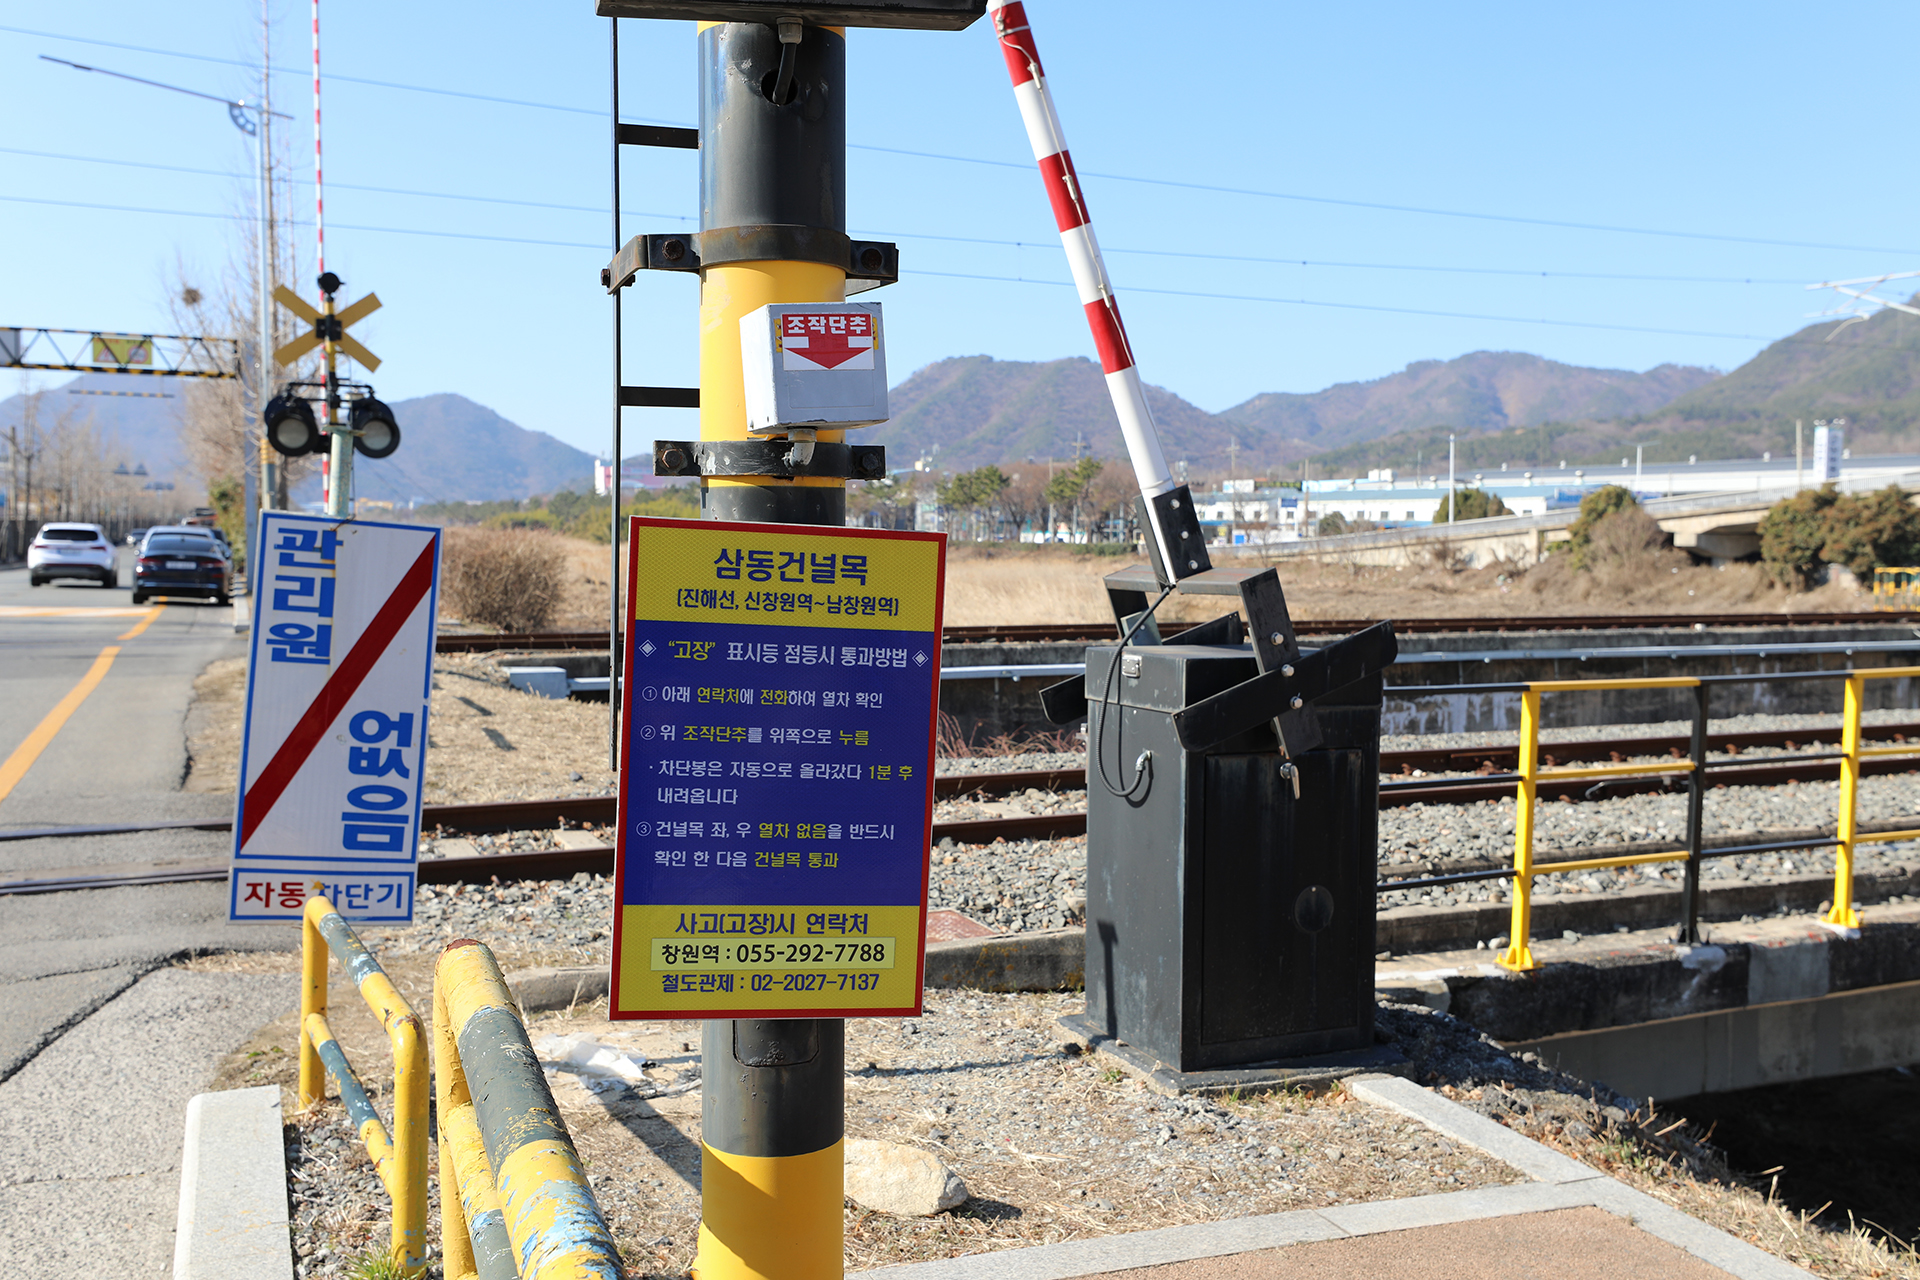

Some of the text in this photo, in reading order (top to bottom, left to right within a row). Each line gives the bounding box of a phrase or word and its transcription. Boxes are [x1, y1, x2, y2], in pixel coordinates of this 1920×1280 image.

[787, 316, 867, 334] 조작단추
[713, 548, 868, 585] 삼동건널목
[266, 527, 344, 665] 관리원
[727, 642, 778, 664] 표시등
[784, 644, 835, 665] 점등시
[841, 646, 907, 668] 통과방법
[662, 686, 691, 703] 아래
[697, 687, 754, 704] 연락처에
[760, 689, 816, 706] 전화하여
[822, 691, 850, 708] 열차
[855, 692, 883, 708] 확인
[660, 725, 676, 740] 위
[683, 726, 762, 743] 조작단추를
[769, 728, 831, 744] 위쪽으로
[839, 730, 869, 745] 누름
[341, 710, 415, 852] 없음
[658, 760, 913, 781] 차단봉은 자동으로 올라갔다 1분 후
[657, 787, 738, 805] 내려옵니다
[656, 822, 704, 838] 건널목
[736, 822, 751, 838] 우
[759, 823, 789, 839] 열차
[796, 824, 842, 840] 없음을
[850, 824, 894, 840] 반드시
[654, 851, 838, 868] 확인 한 다음 건널목 통과
[244, 882, 306, 909] 자동
[806, 913, 868, 935] 연락처
[661, 944, 720, 965] 창원역
[736, 944, 885, 963] 055-292-7788
[661, 974, 733, 992] 철도관제
[751, 973, 880, 991] 02-2027-7137
